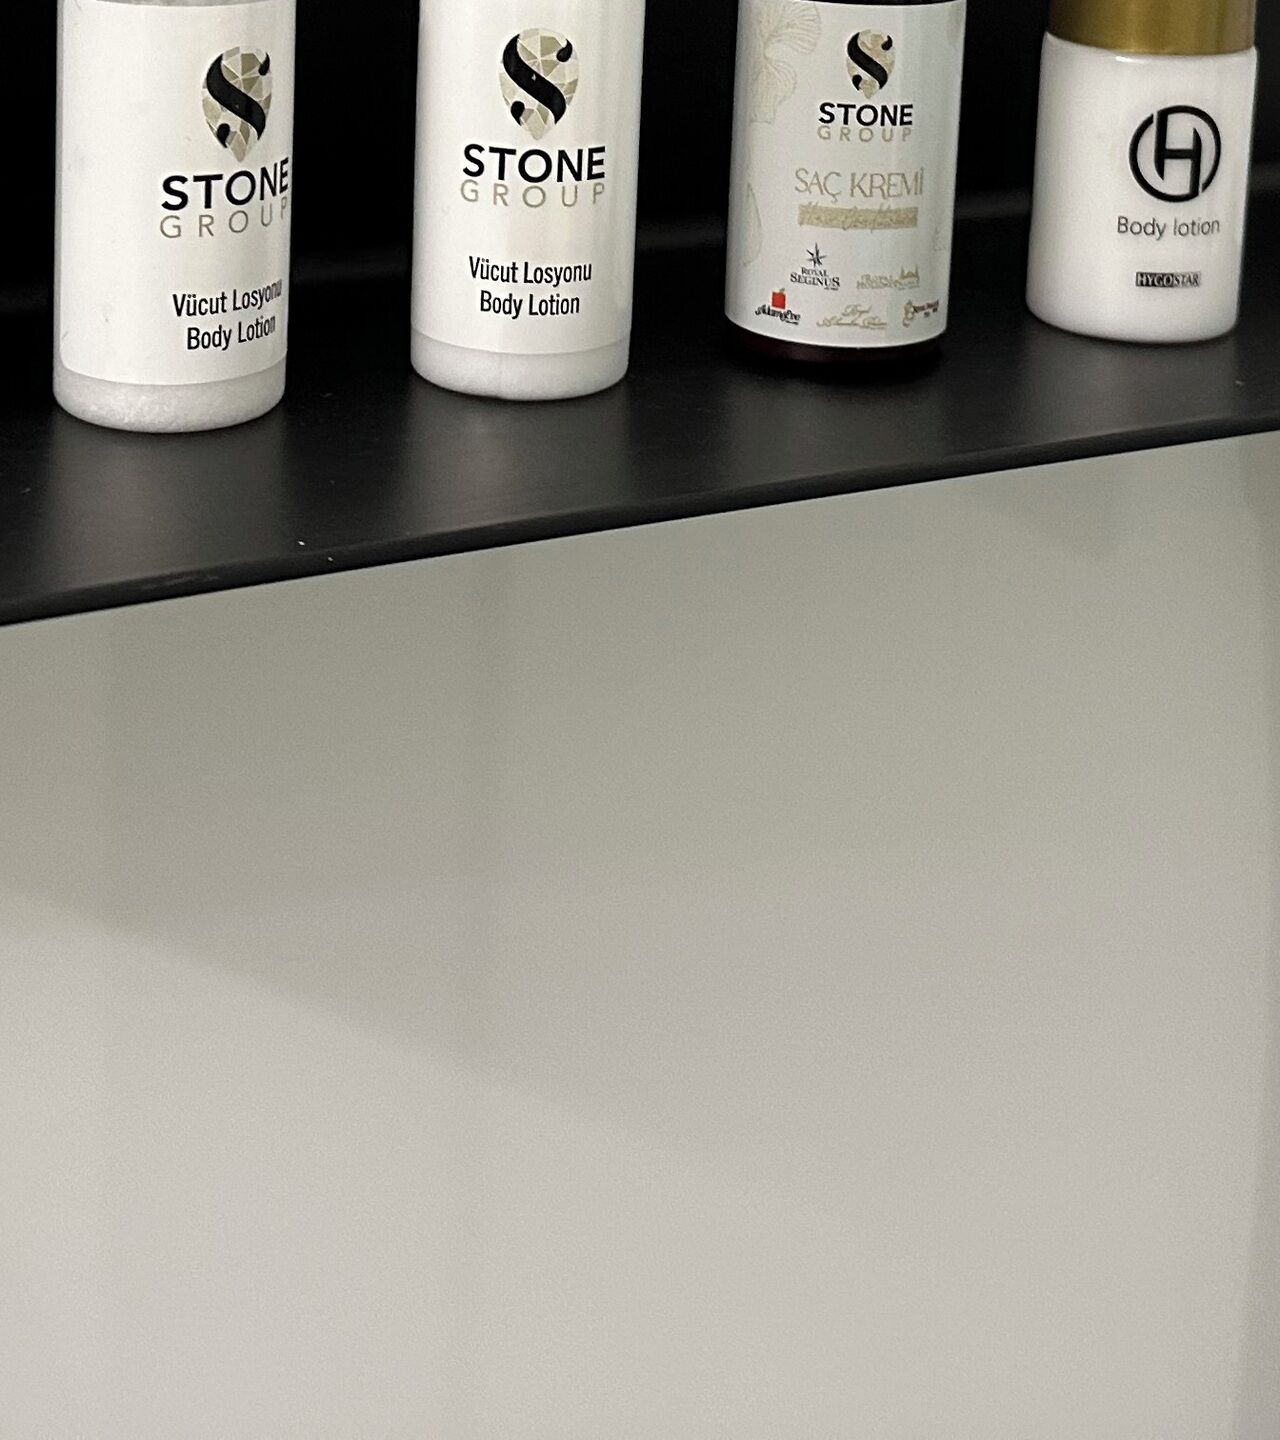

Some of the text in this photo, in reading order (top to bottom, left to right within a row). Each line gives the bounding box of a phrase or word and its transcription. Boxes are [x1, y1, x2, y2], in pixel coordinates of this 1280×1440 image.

[818, 101, 914, 127] STONE
[816, 125, 913, 143] GROUP
[462, 143, 606, 184] STONE
[160, 156, 290, 212] STONE
[460, 179, 606, 208] GROUP
[794, 165, 925, 204] SAÇ KREMİ
[159, 195, 288, 239] GROUP
[1116, 215, 1221, 241] Body lotion
[469, 255, 593, 288] Vücut Losyonu
[790, 271, 841, 288] SEGINUS
[1135, 271, 1201, 288] HYGOSTAR
[172, 278, 283, 317] Vücut Losyonu
[479, 289, 581, 320] Body Lotion
[186, 315, 277, 351] Body Lotion
